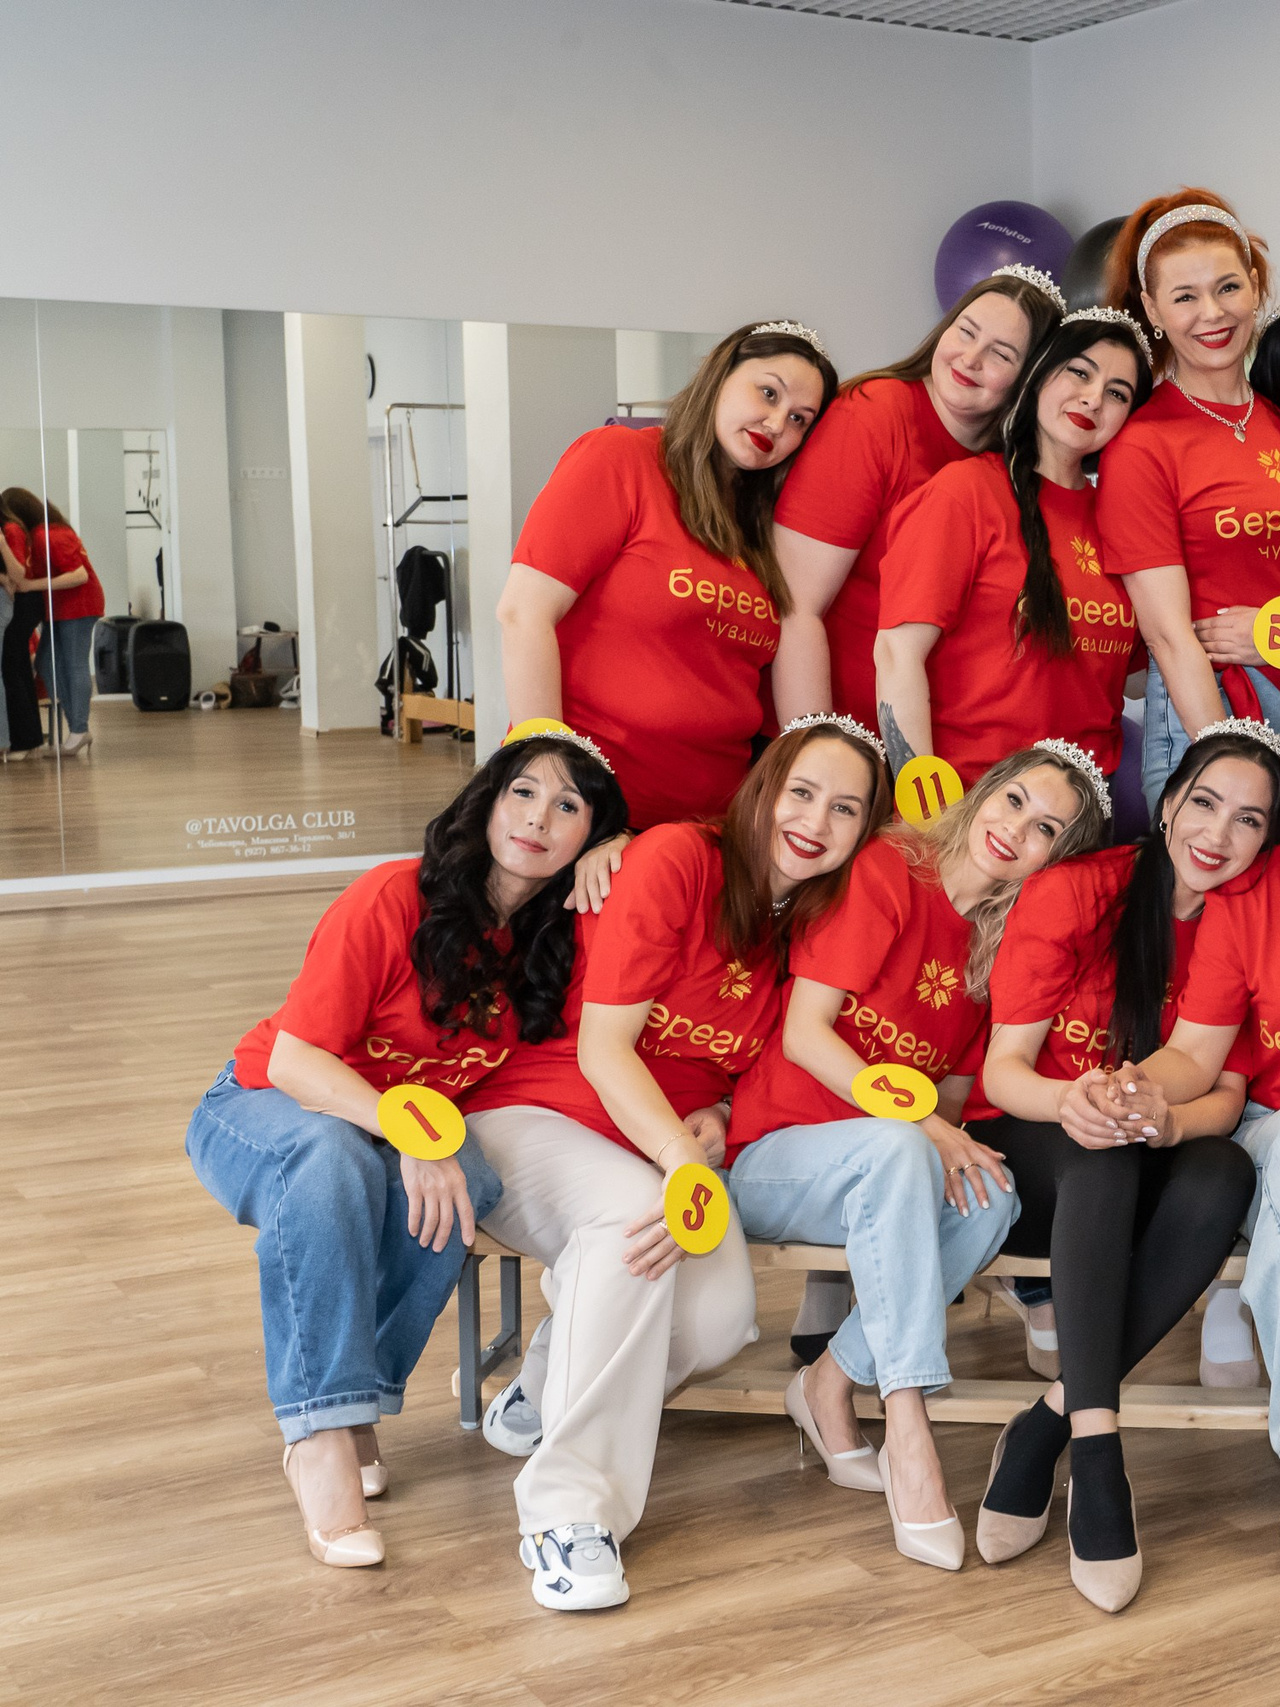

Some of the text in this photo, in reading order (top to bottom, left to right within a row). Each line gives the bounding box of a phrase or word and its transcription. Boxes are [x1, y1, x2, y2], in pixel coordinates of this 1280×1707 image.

[1066, 596, 1135, 628] реги
[911, 771, 947, 820] 11
[185, 810, 356, 836] @TAVOLGA CLUB
[403, 1100, 442, 1142] 1
[682, 1183, 713, 1231] 5
